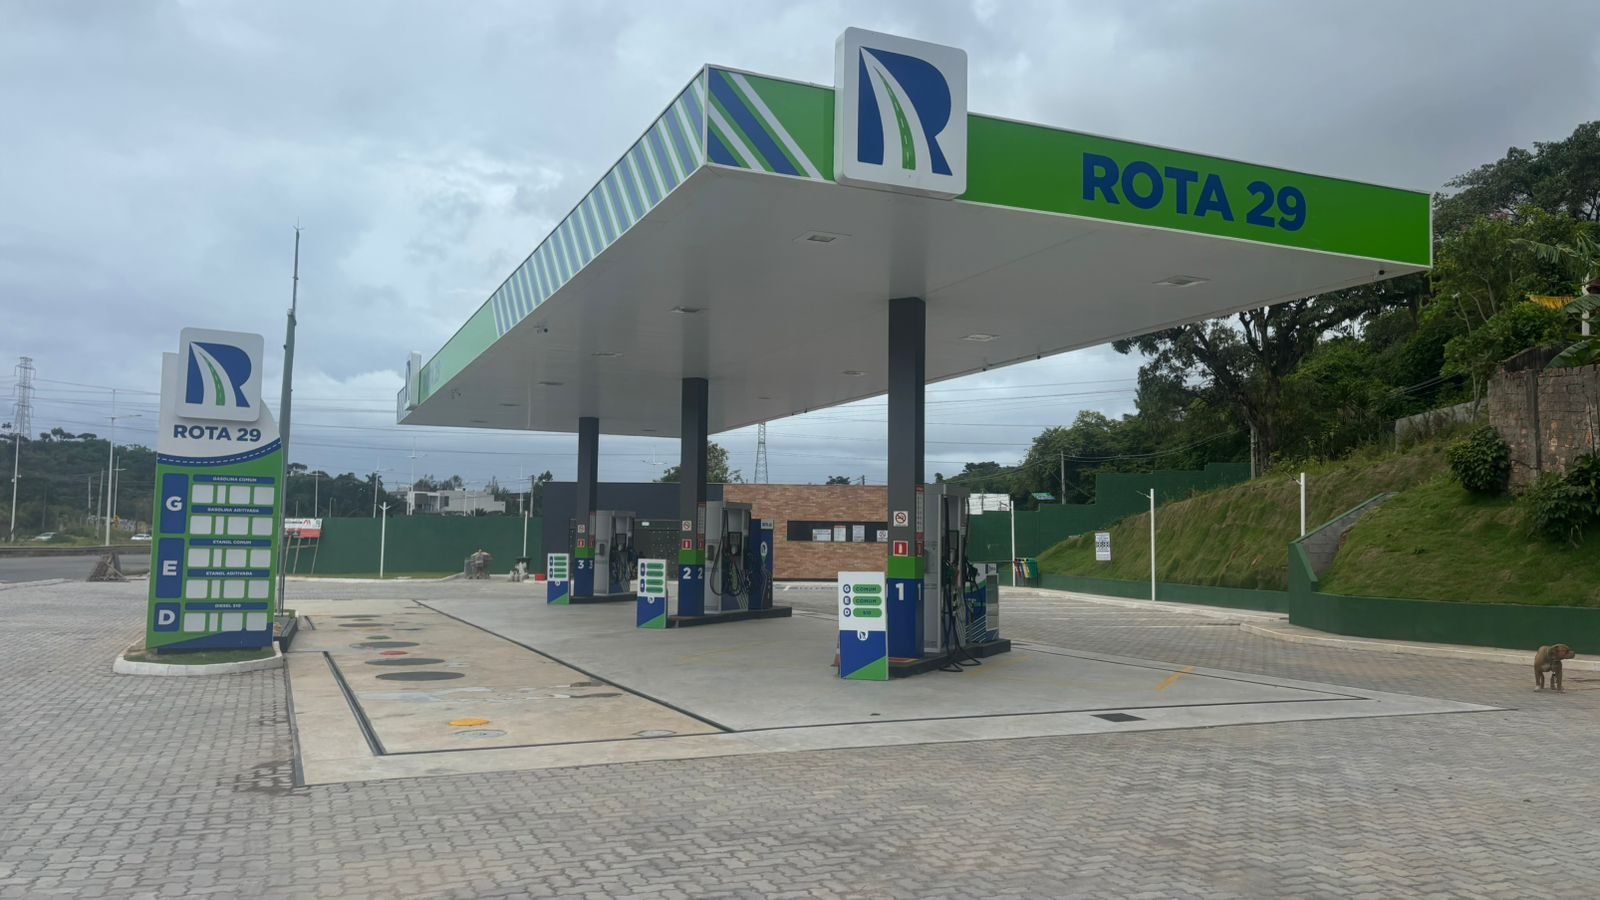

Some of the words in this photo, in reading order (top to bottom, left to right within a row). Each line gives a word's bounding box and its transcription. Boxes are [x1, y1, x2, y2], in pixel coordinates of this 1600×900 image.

[1082, 152, 1234, 223] ROTA
[1246, 181, 1307, 232] 29
[173, 424, 232, 441] ROTA
[236, 427, 262, 442] 29
[166, 496, 183, 512] G
[162, 560, 178, 576] E
[578, 560, 585, 569] 3
[682, 566, 691, 579] 2
[697, 567, 703, 579] 2
[895, 583, 904, 600] 1
[158, 609, 176, 625] D
